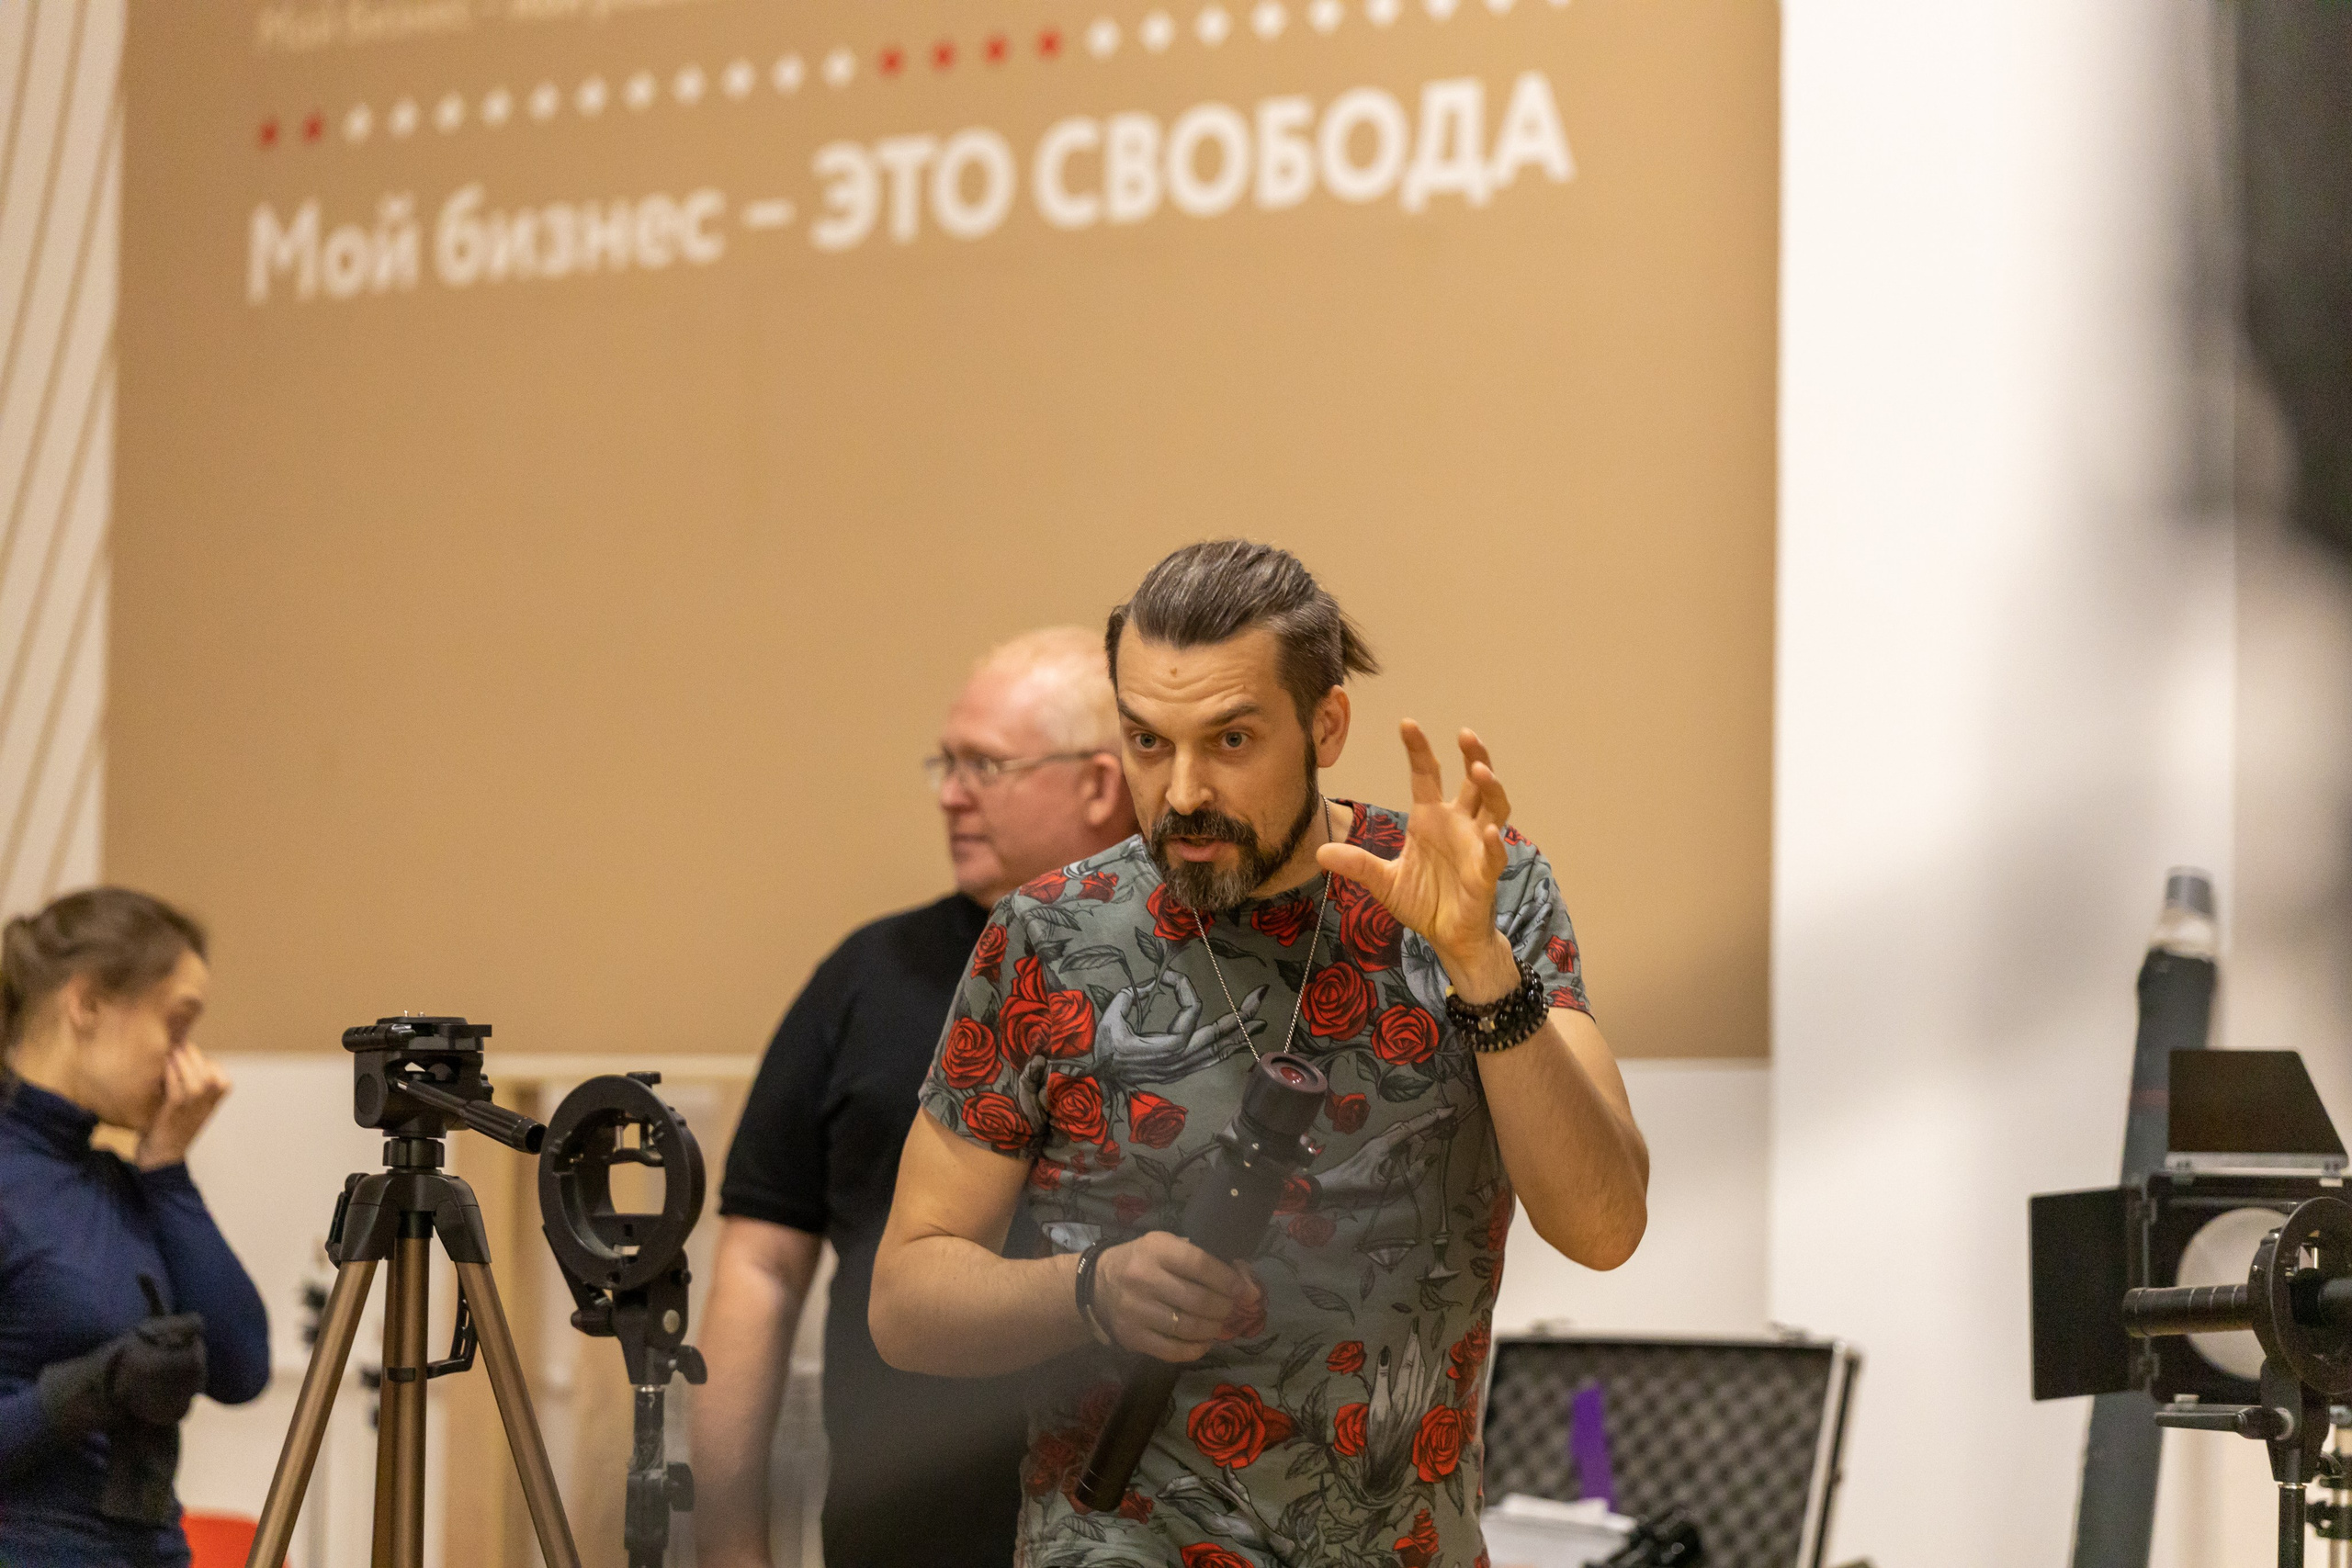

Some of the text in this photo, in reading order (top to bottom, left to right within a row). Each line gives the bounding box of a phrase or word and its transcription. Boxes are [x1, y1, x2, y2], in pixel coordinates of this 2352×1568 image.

[247, 192, 421, 301] Мой
[435, 184, 726, 285] бизнес
[810, 127, 1016, 251] ЭТО
[1033, 70, 1576, 229] СВОБОДА
